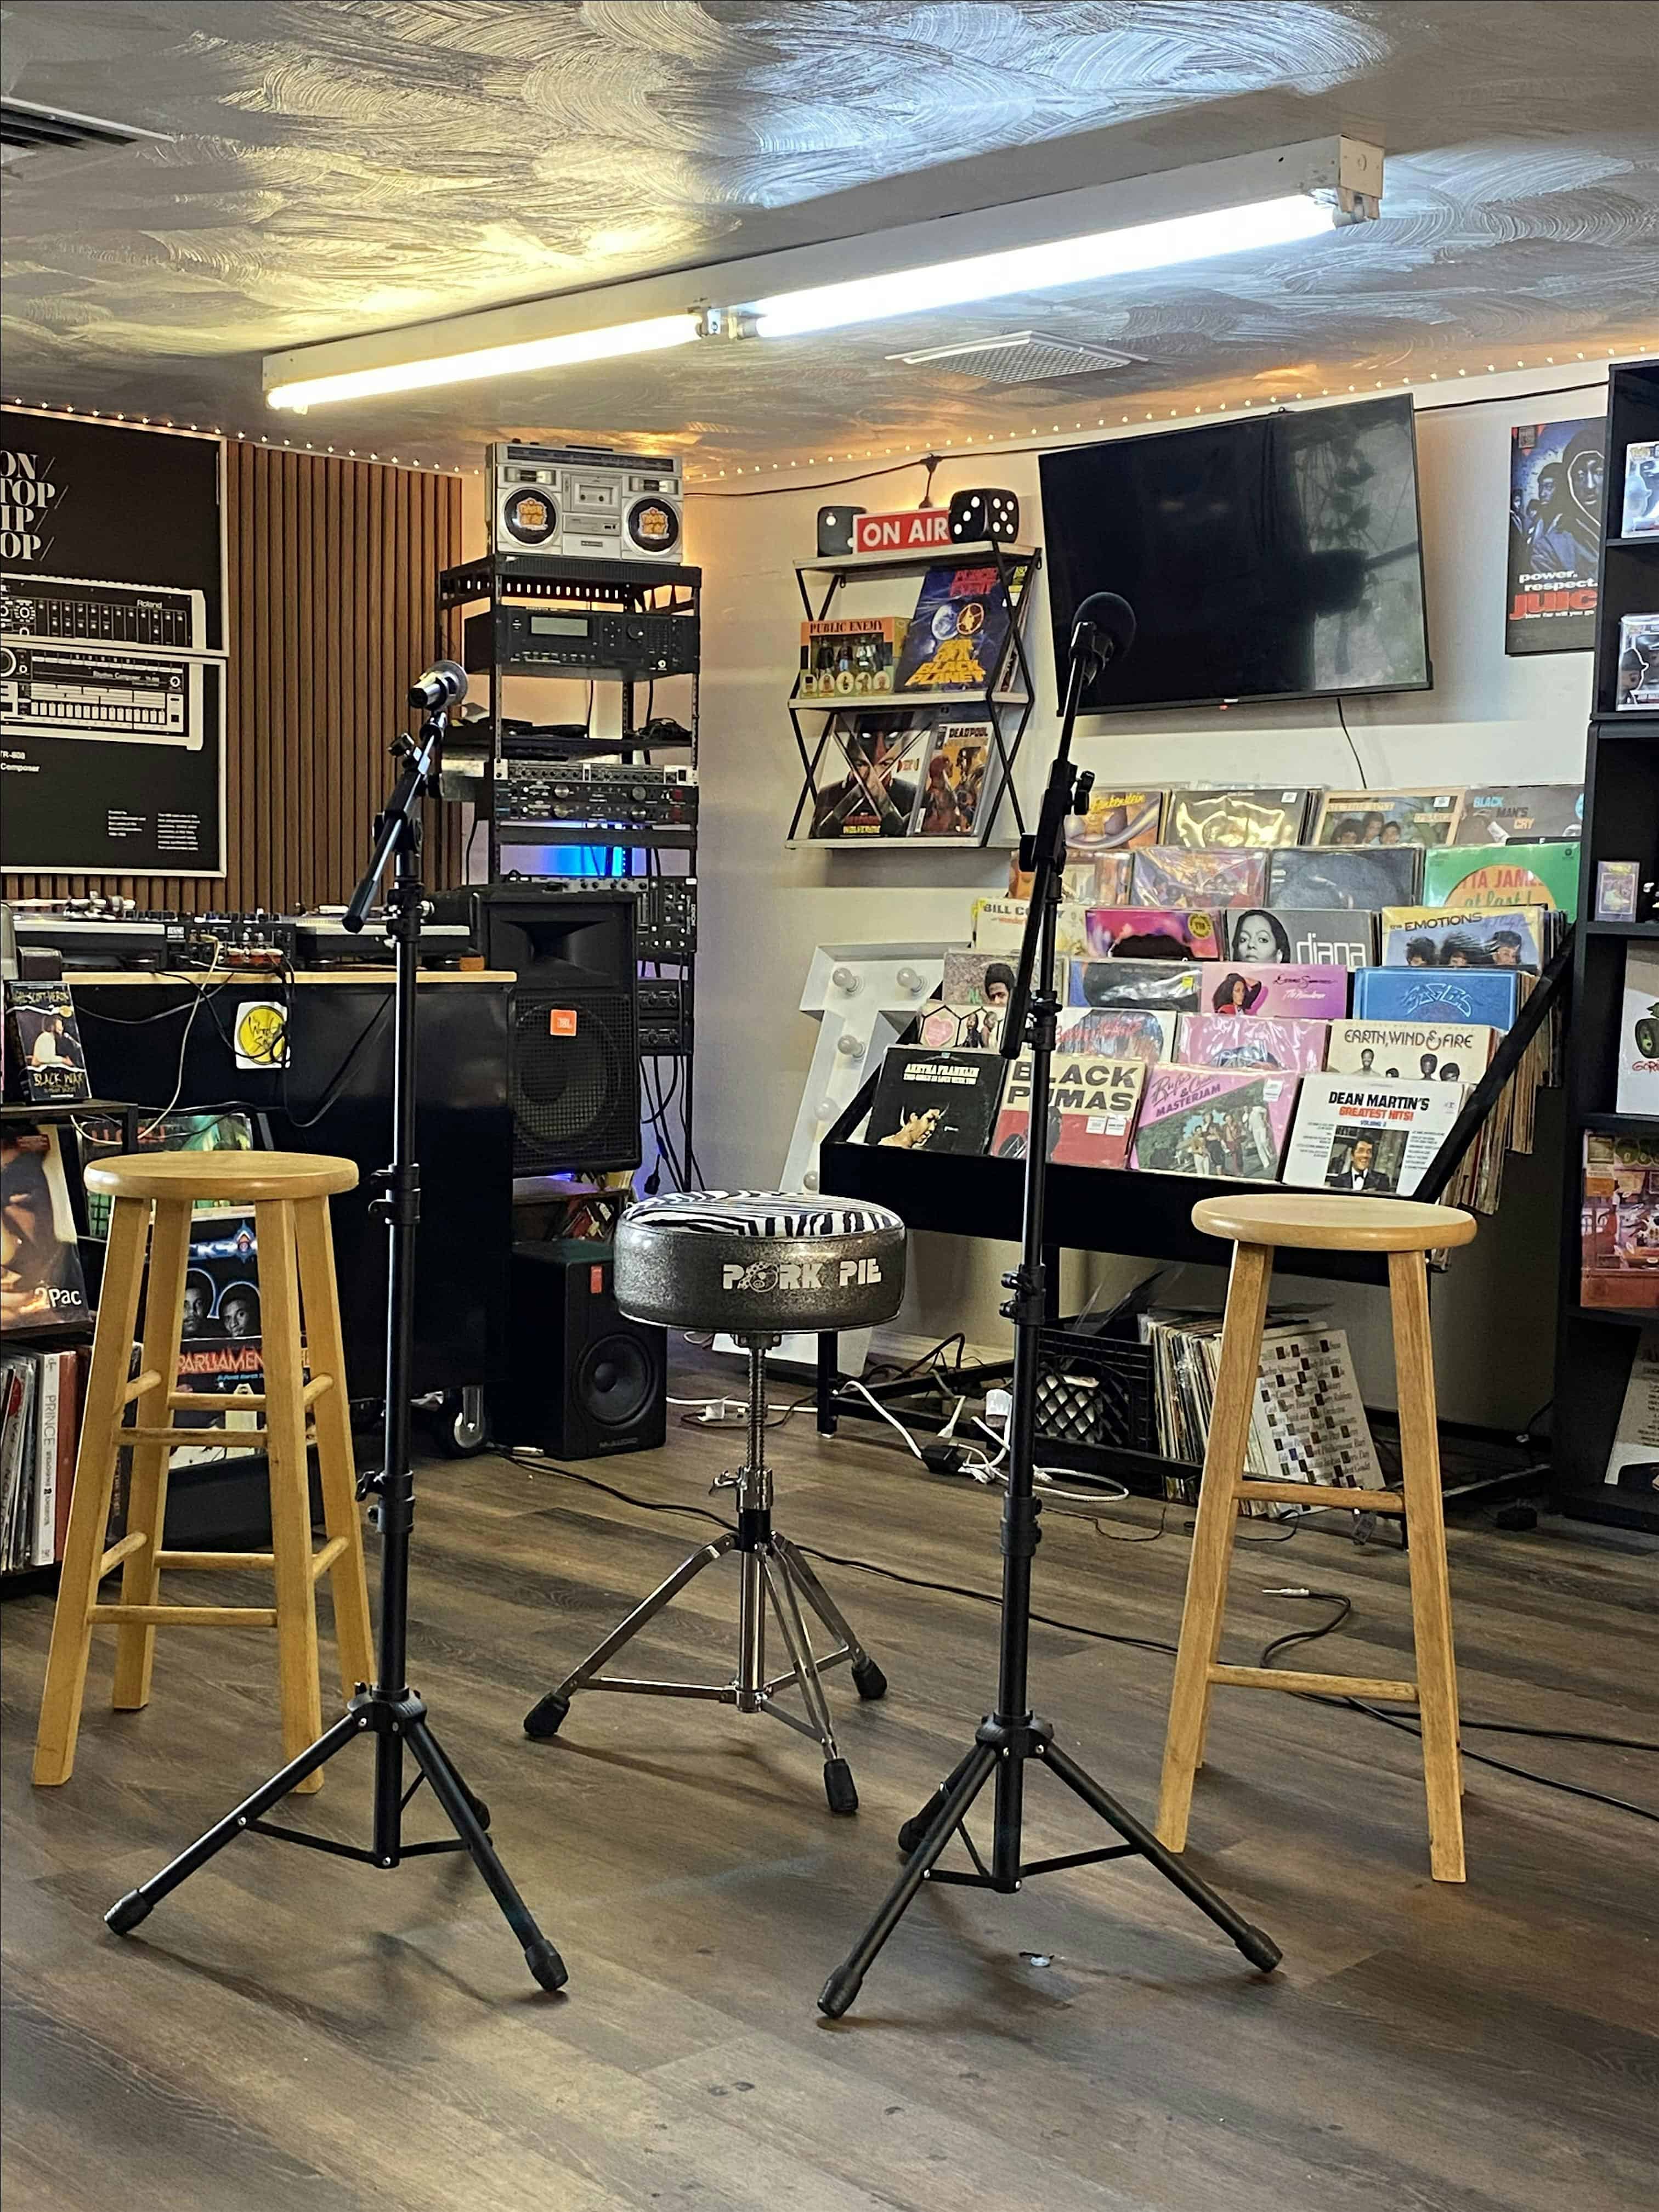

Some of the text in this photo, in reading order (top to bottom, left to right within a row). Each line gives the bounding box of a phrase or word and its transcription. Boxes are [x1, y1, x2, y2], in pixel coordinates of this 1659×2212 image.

[863, 517, 949, 547] ON AIR
[1509, 589, 1598, 620] JUIC
[809, 620, 882, 633] PUBLIC ENEMY
[921, 660, 982, 674] BLACK
[904, 672, 987, 686] PLANET
[949, 727, 988, 738] DEADPOOL
[1473, 796, 1504, 808] BLACK
[1513, 817, 1535, 830] CRY
[984, 904, 1011, 914] BILL
[1404, 912, 1483, 931] EMOTIONS
[1296, 932, 1367, 968] diana
[1388, 1031, 1425, 1046] WIND
[1425, 1029, 1442, 1051] &
[1442, 1034, 1474, 1049] FIRE
[1012, 1061, 1139, 1089] BACK
[1007, 1085, 1134, 1112] PMAS
[1156, 1083, 1221, 1117] MASTERJAM
[1328, 1091, 1364, 1106] DEAN
[1366, 1094, 1430, 1111] MARTIN'S
[1339, 1106, 1414, 1122] GREATEST HITS!
[722, 1258, 882, 1293] PORK PIE
[34, 1287, 82, 1309] 2Pac
[178, 1346, 264, 1373] PARLIAMEN
[43, 1395, 56, 1446] PRINCE
